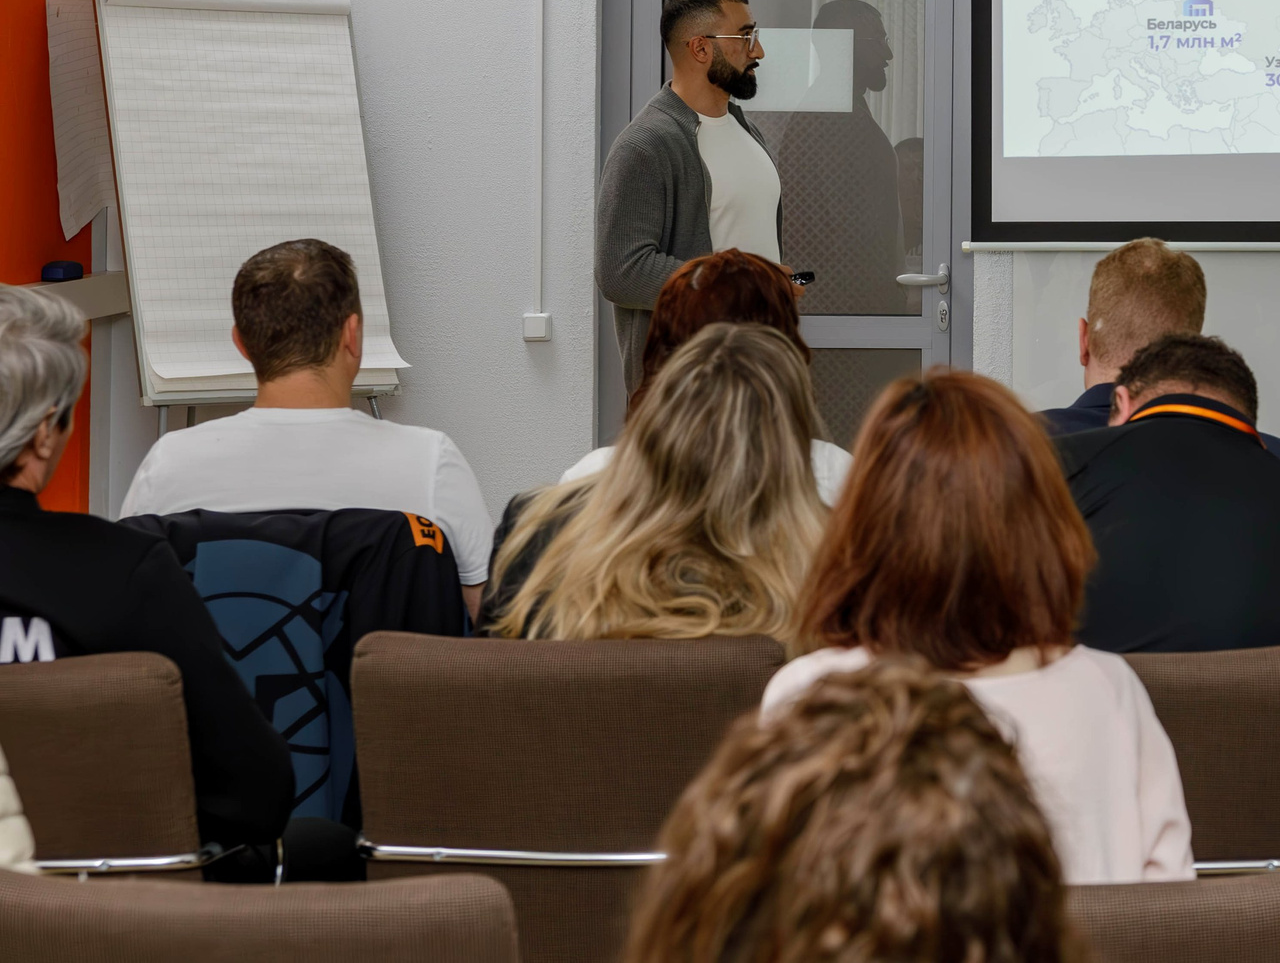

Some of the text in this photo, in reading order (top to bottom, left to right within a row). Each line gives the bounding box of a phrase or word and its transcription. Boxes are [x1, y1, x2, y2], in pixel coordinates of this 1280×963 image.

[1147, 18, 1217, 33] Беларусь
[1147, 35, 1171, 52] 1,7
[1176, 37, 1214, 49] млн
